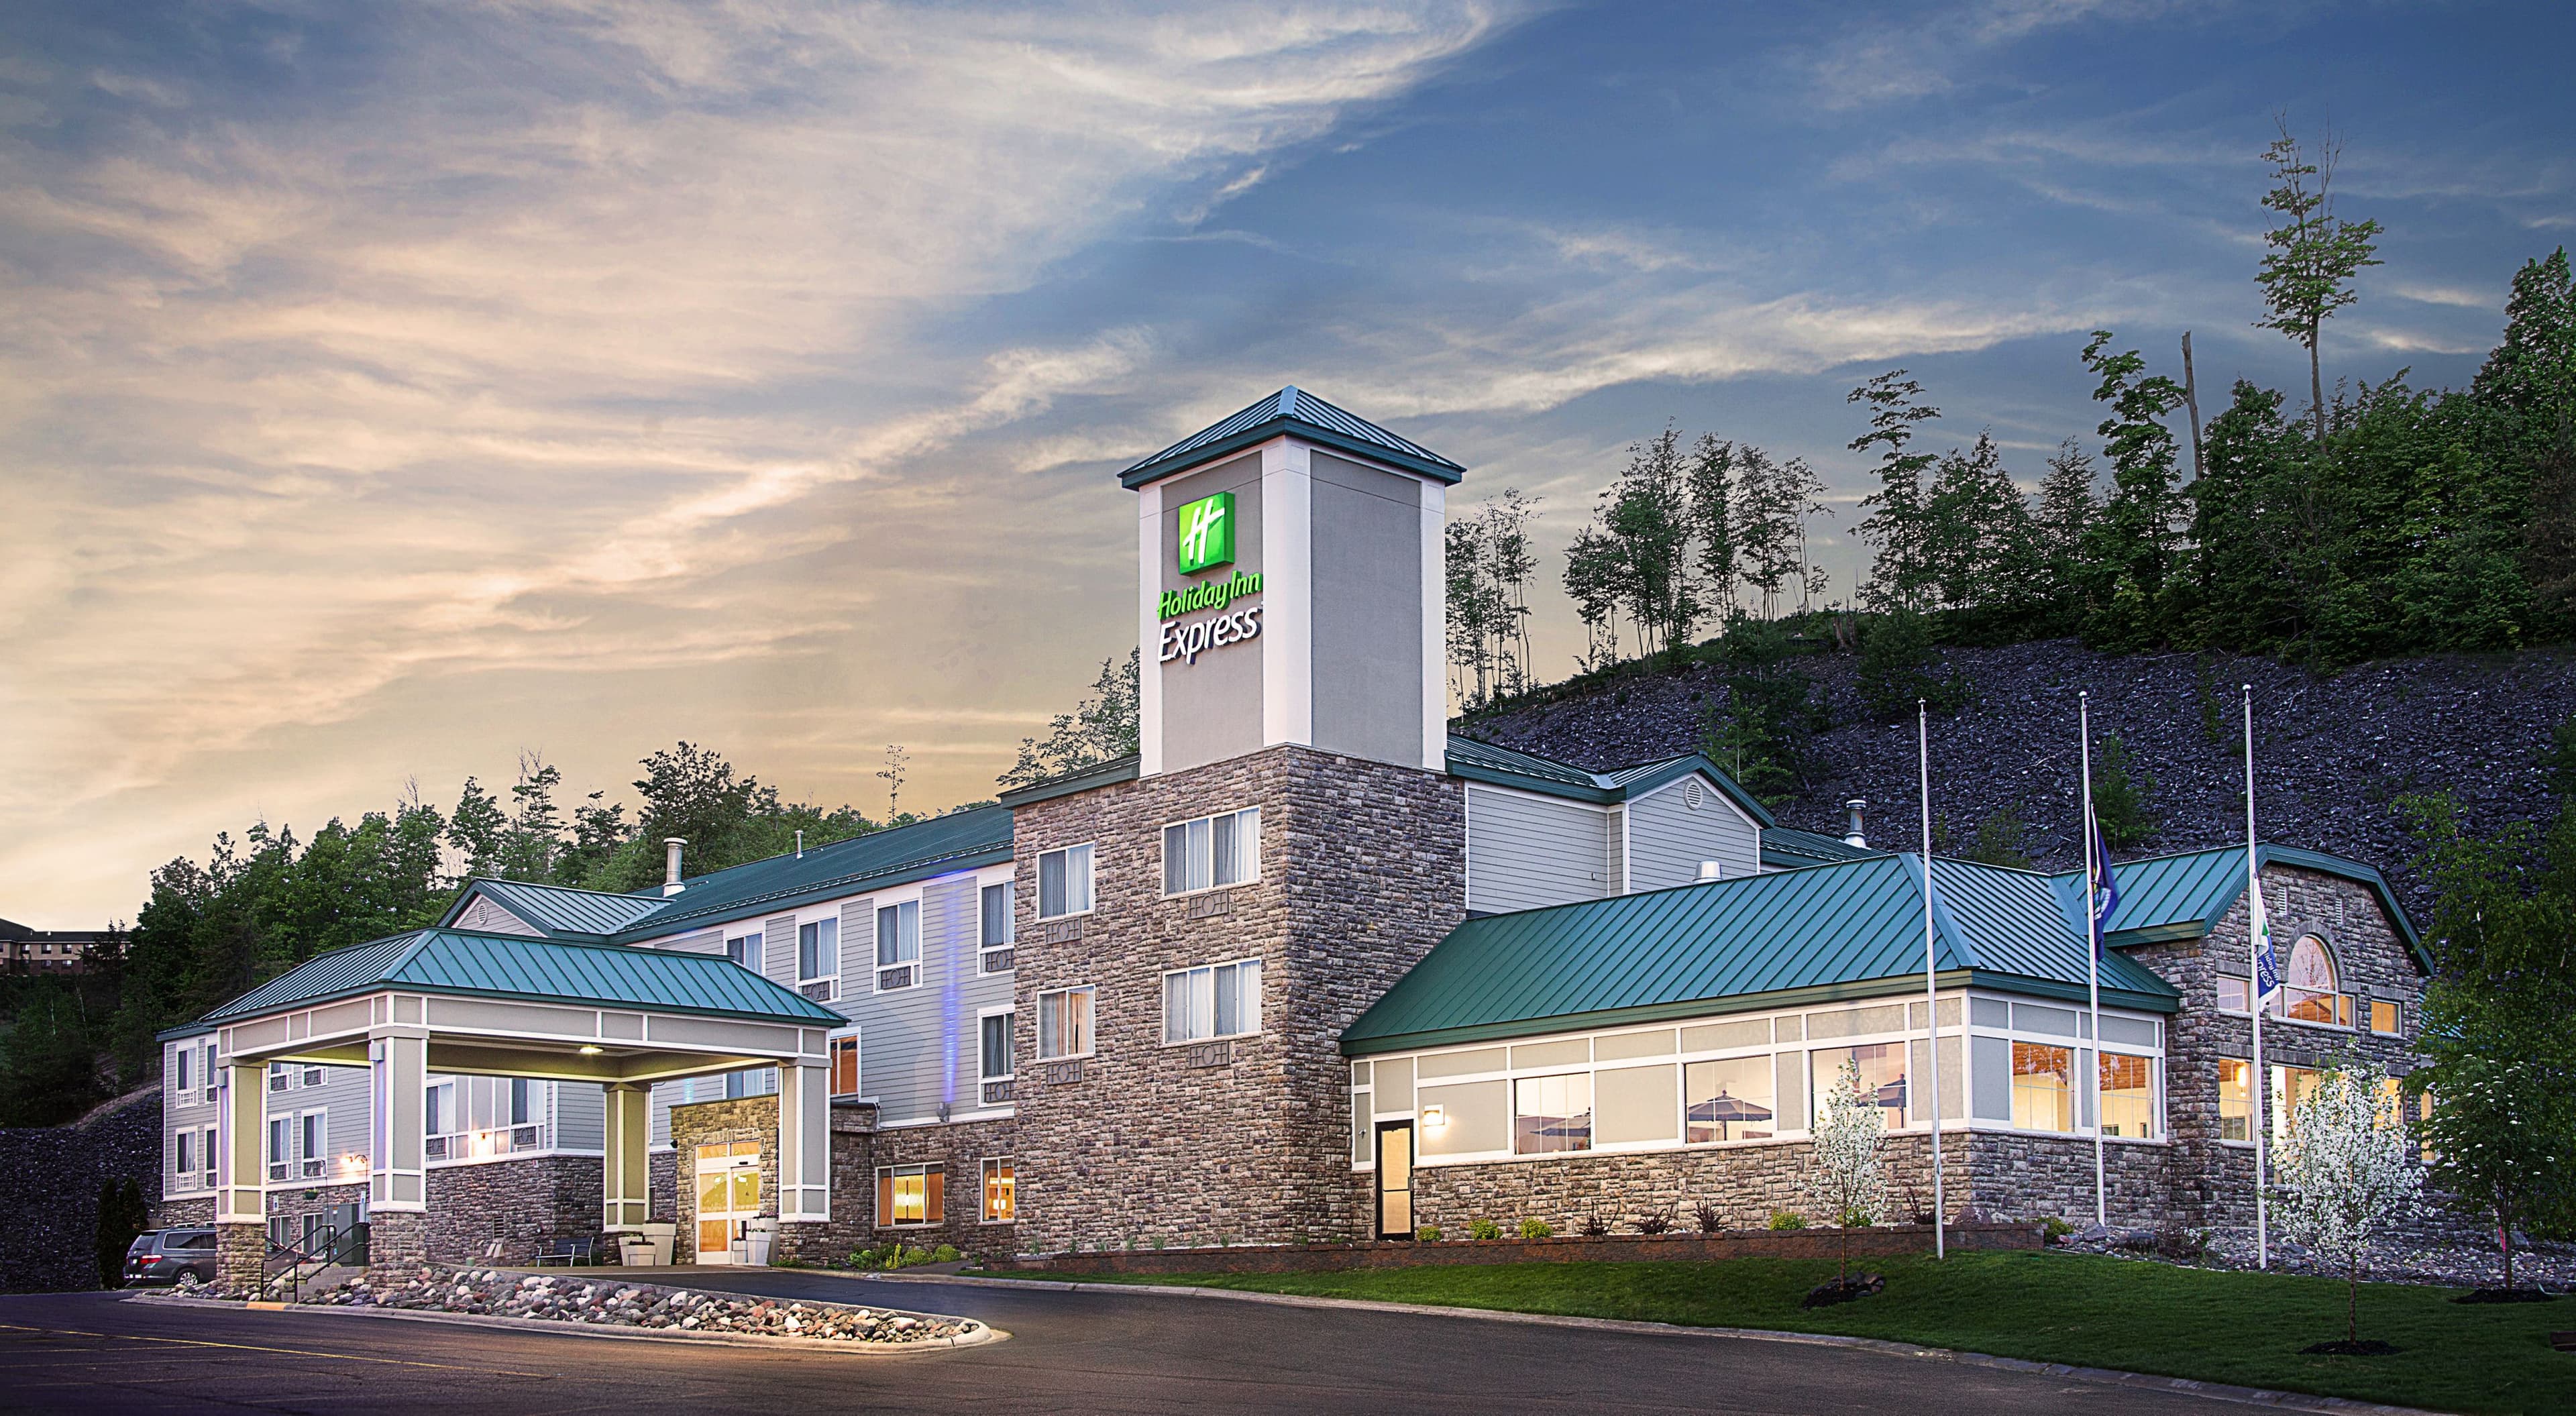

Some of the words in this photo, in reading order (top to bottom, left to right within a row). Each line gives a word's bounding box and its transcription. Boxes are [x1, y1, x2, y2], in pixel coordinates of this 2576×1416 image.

[1183, 498, 1225, 563] H
[1157, 580, 1229, 620] Holiday
[1230, 569, 1261, 599] Inn
[1157, 606, 1260, 664] Express
[2257, 959, 2275, 987] press
